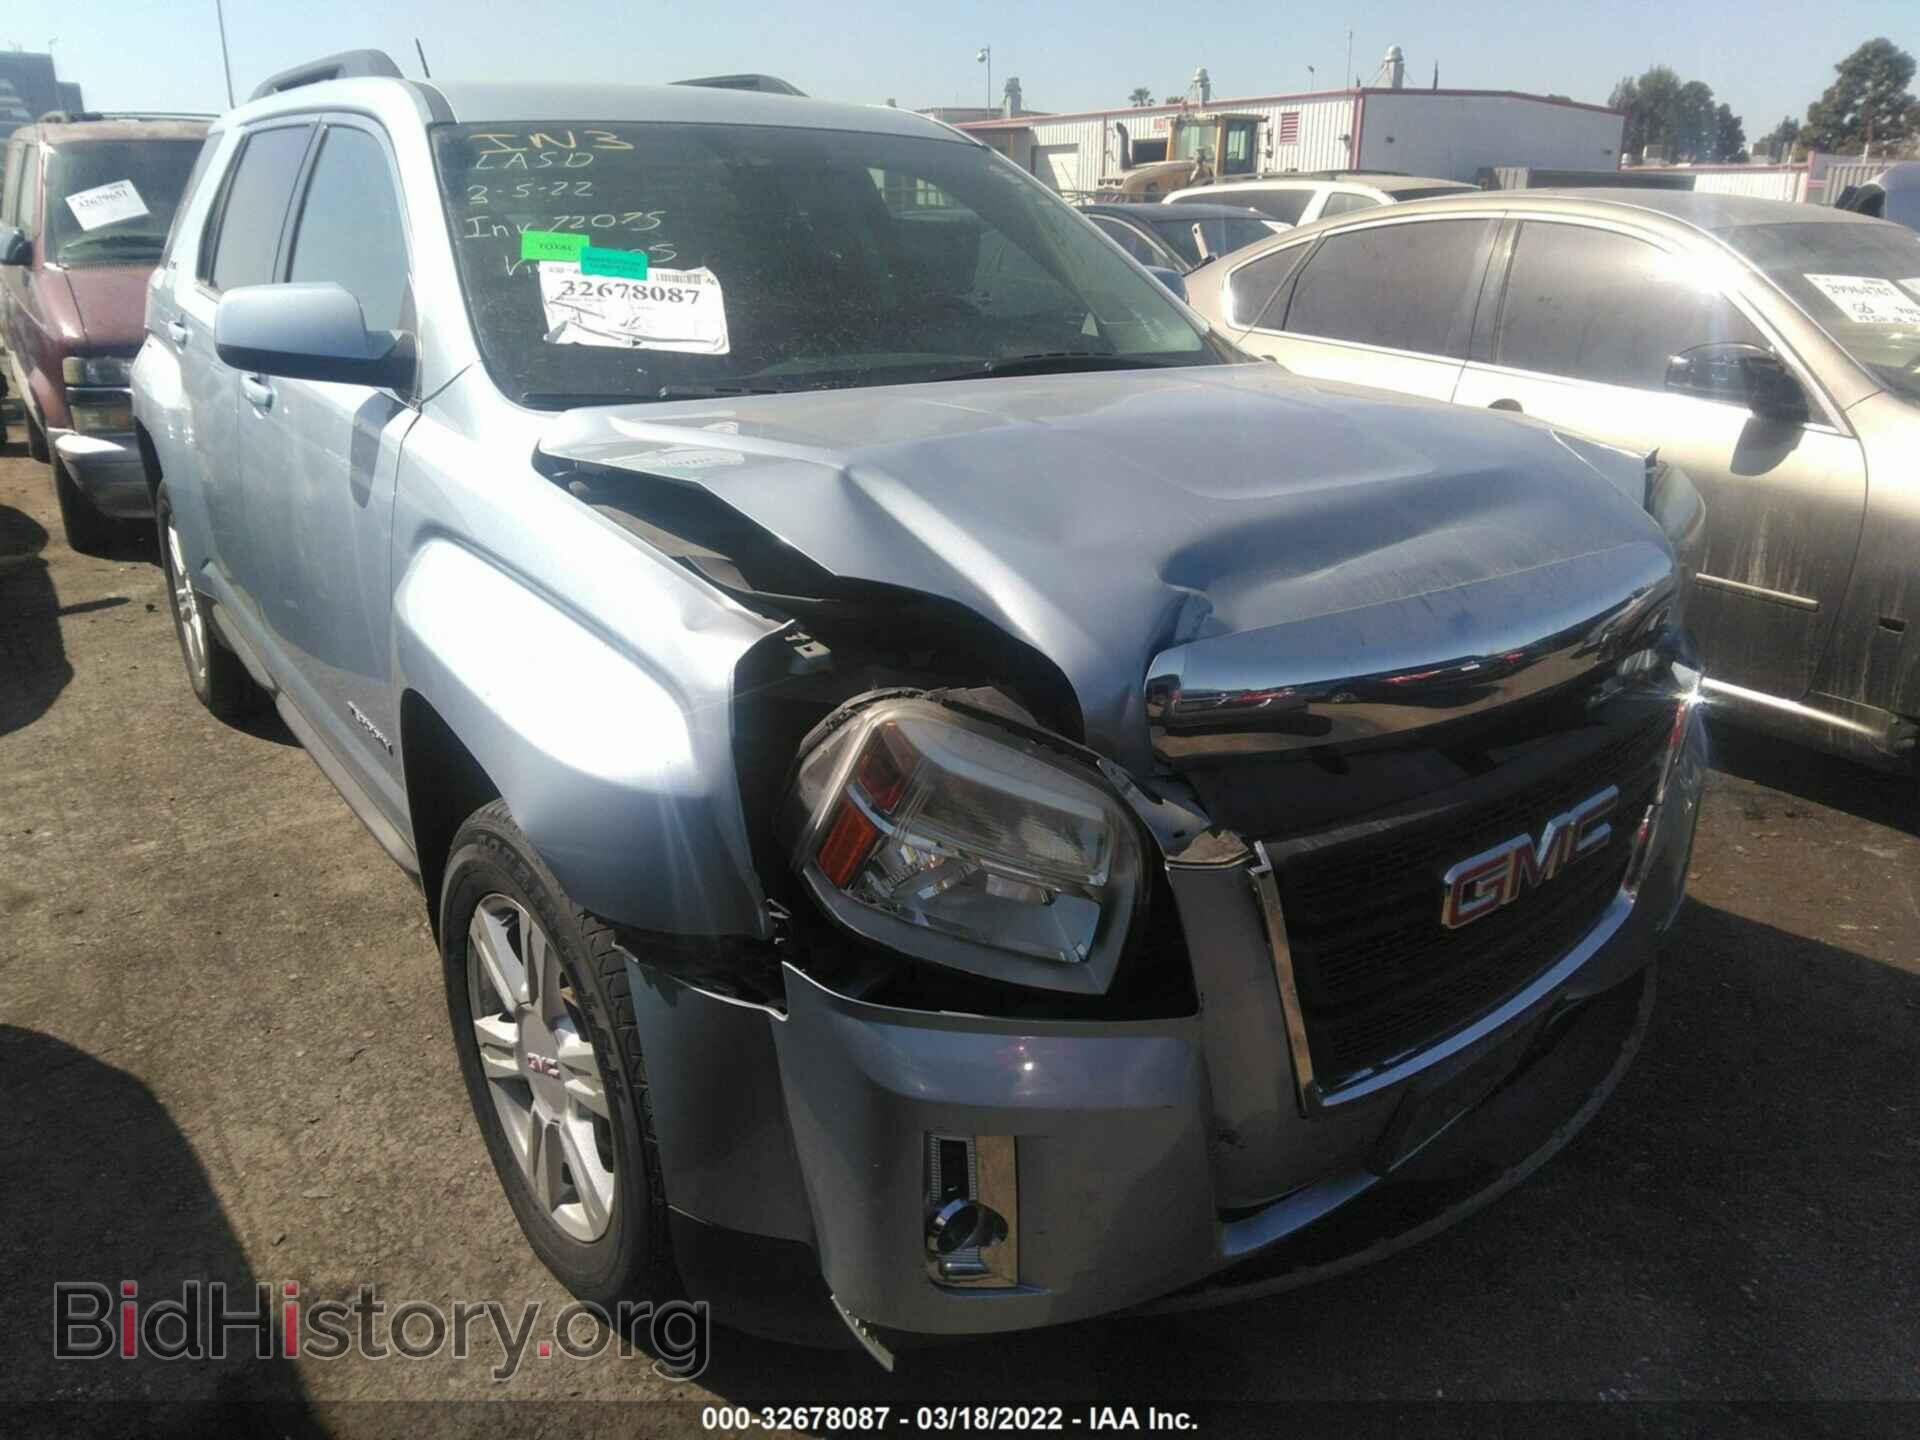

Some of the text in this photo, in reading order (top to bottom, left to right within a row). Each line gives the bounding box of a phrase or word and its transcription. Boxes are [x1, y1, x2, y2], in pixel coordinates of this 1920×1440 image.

[474, 151, 594, 170] LASD
[464, 214, 531, 239] Inv
[556, 279, 700, 305] 32678087
[1440, 784, 1619, 929] GMC
